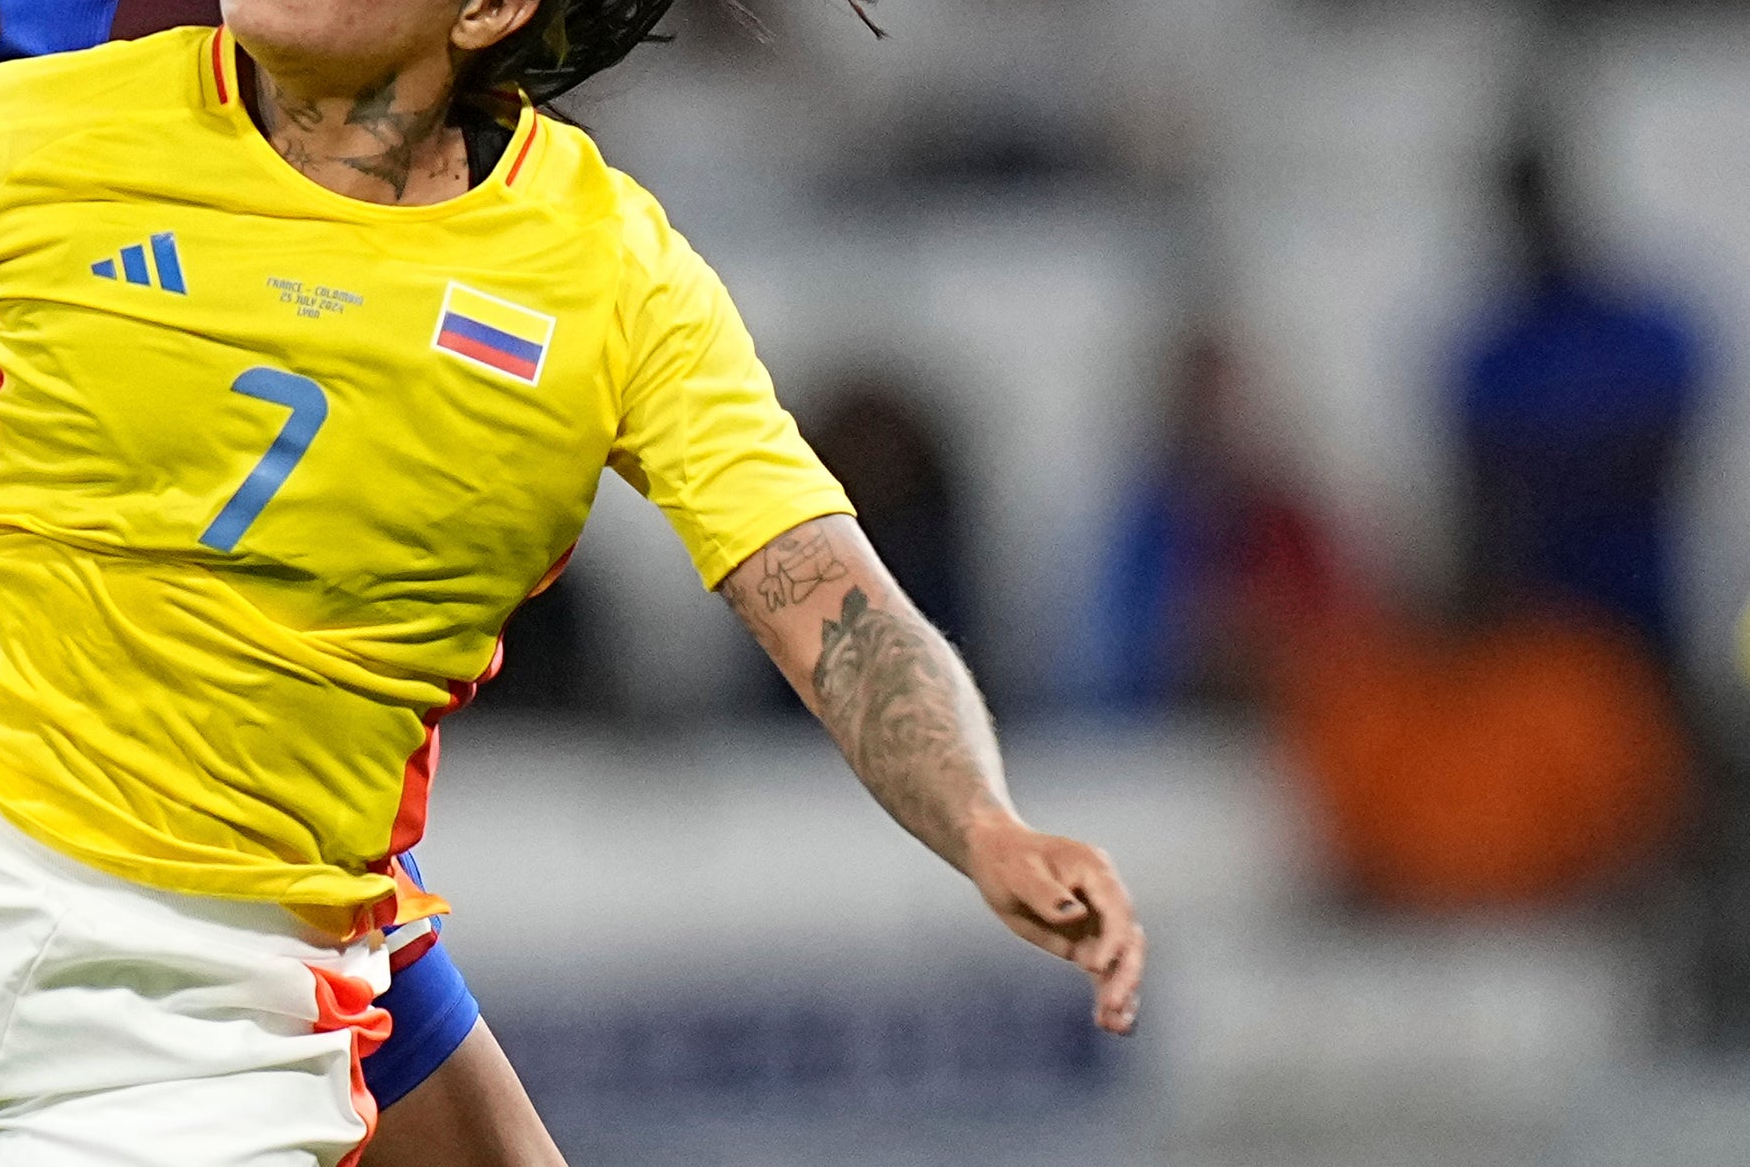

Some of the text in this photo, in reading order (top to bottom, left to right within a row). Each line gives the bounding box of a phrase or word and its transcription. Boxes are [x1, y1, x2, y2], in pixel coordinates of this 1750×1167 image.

[266, 277, 303, 293] FRANCE
[280, 292, 344, 314] 25 JULY 2024
[296, 307, 321, 320] LYON
[198, 366, 328, 552] 7
